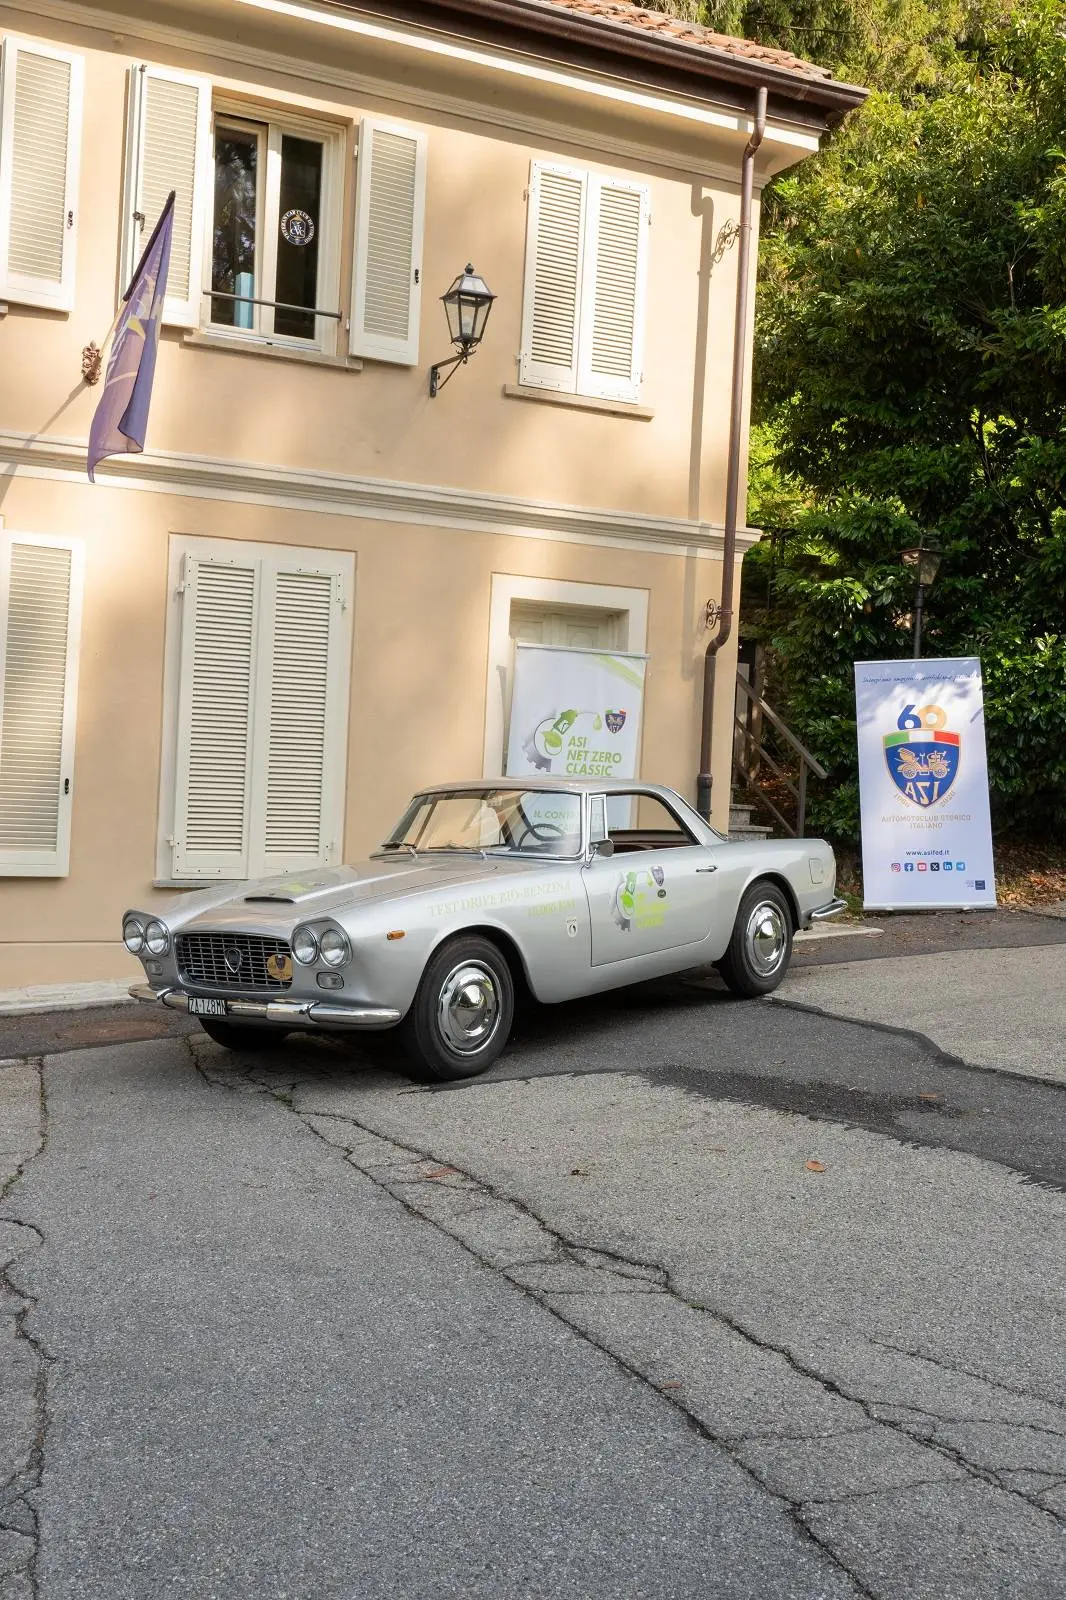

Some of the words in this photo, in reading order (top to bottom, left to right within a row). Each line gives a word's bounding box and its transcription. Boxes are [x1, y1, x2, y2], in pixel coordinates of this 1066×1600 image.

[897, 704, 947, 730] 60
[568, 735, 588, 748] ASI
[567, 750, 589, 761] NET
[591, 751, 622, 764] ZERO
[566, 762, 613, 776] CLASSIC
[904, 781, 940, 805] ASI
[881, 814, 939, 823] AUTOMOTOCLUB
[940, 813, 971, 821] STORICO
[427, 901, 460, 917] TEST
[462, 893, 496, 911] DRIVE
